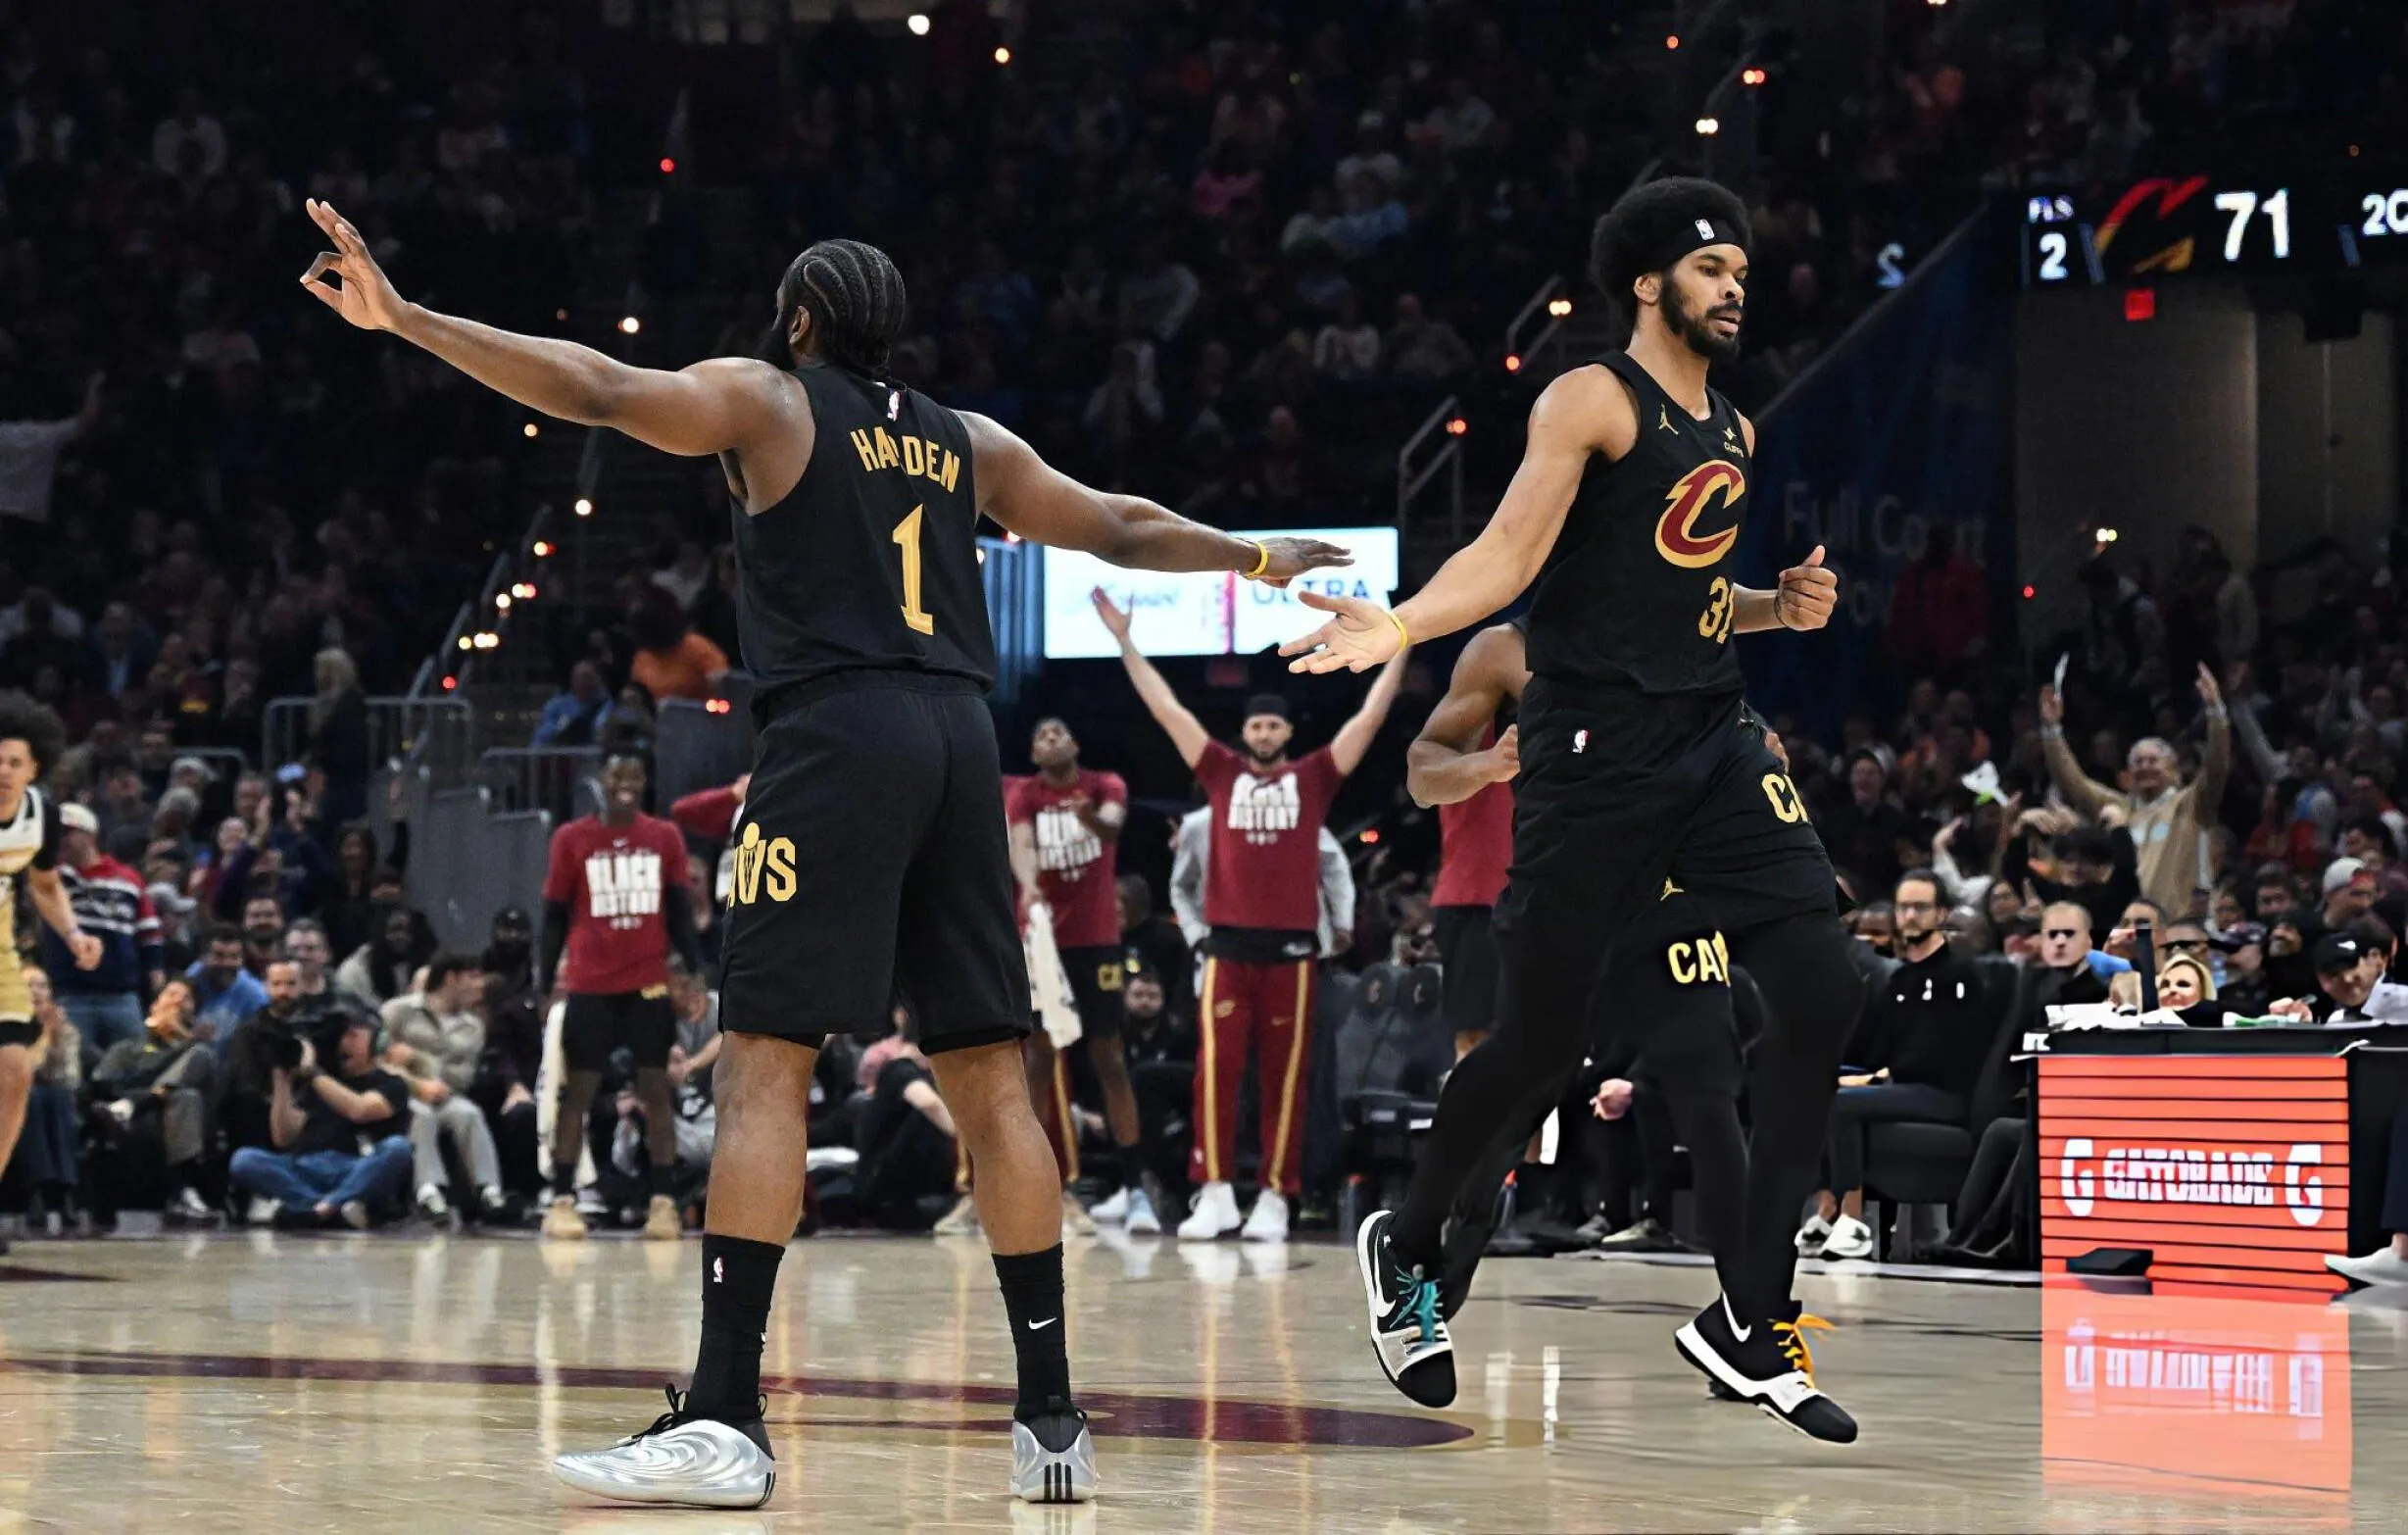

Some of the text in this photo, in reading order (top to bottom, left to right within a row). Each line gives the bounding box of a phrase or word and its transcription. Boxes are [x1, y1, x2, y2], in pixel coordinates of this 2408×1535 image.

[2039, 231, 2069, 281] 2
[2214, 187, 2290, 262] 71
[851, 425, 960, 493] HADEN
[892, 503, 934, 636] 1
